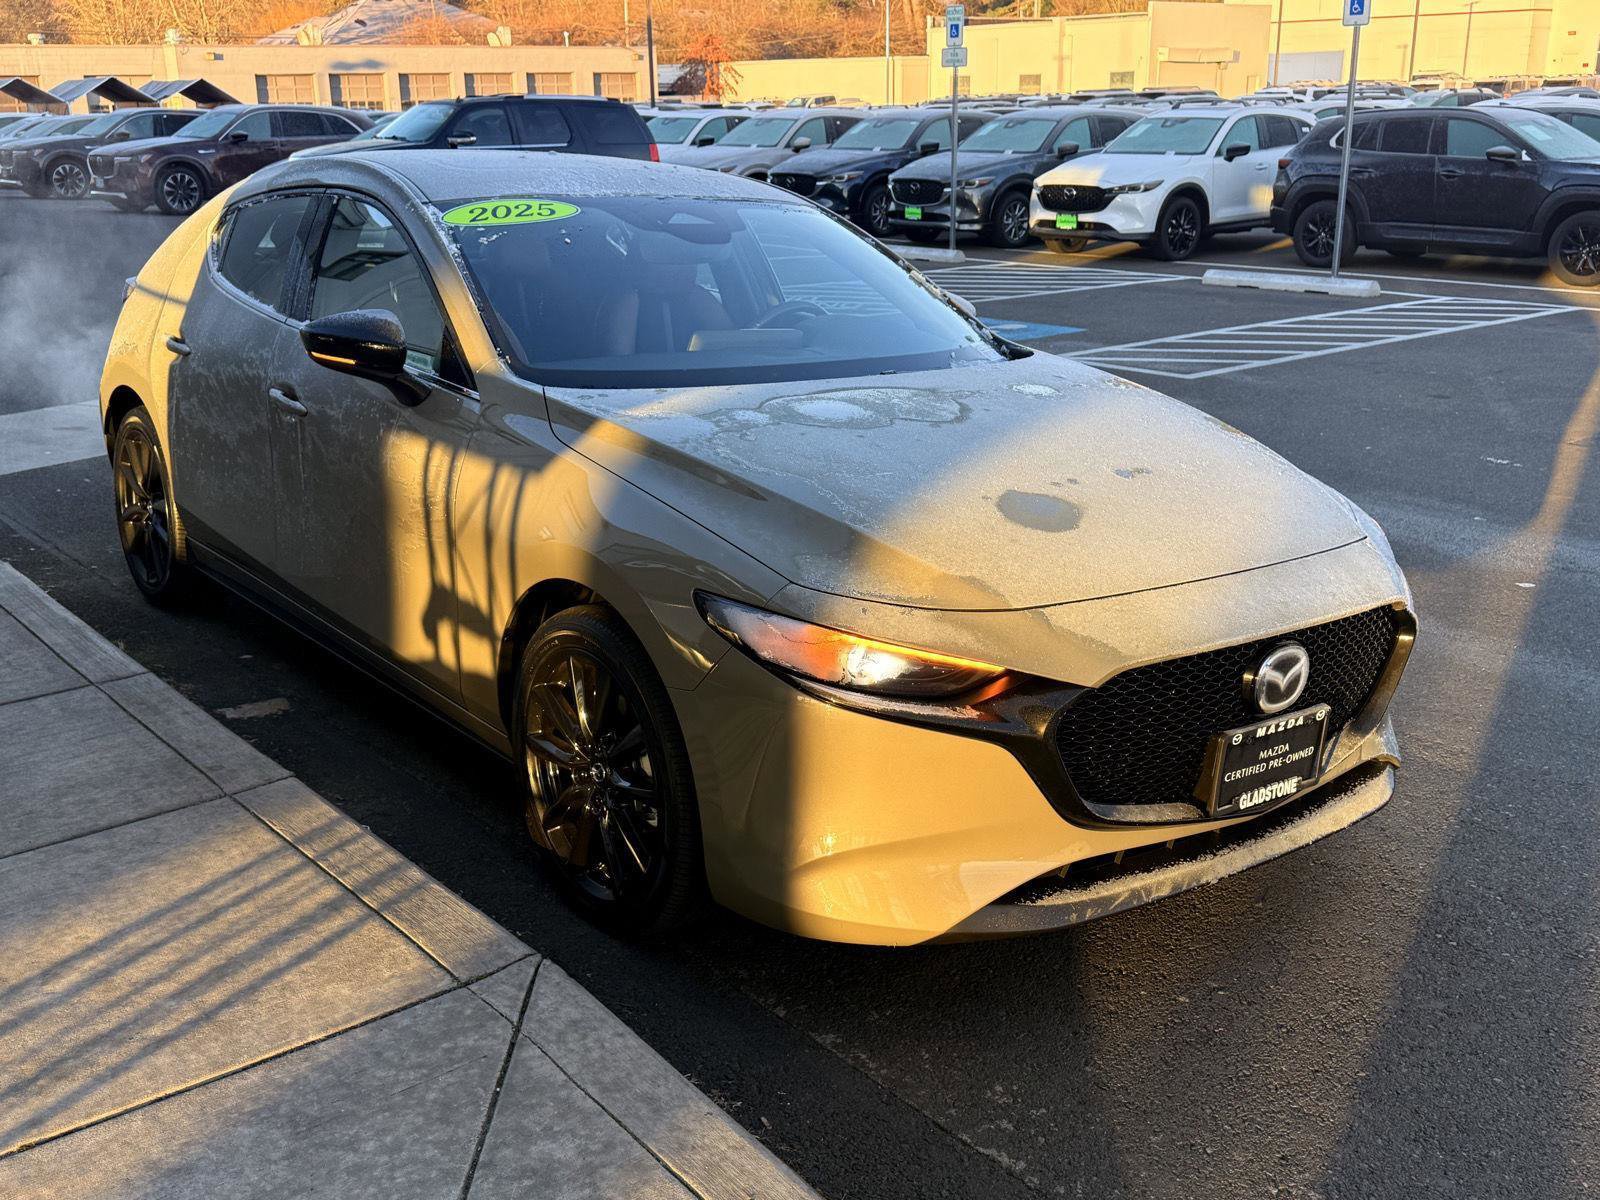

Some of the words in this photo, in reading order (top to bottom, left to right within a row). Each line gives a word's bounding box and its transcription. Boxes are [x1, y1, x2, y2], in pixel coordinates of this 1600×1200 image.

[468, 203, 556, 223] 2025
[1256, 715, 1304, 738] MAZDA
[1258, 743, 1290, 760] MAZDA
[1224, 762, 1267, 782] CERTIFIED
[1268, 746, 1315, 770] PRE-OWNED
[1239, 778, 1299, 810] GLADSTONE
